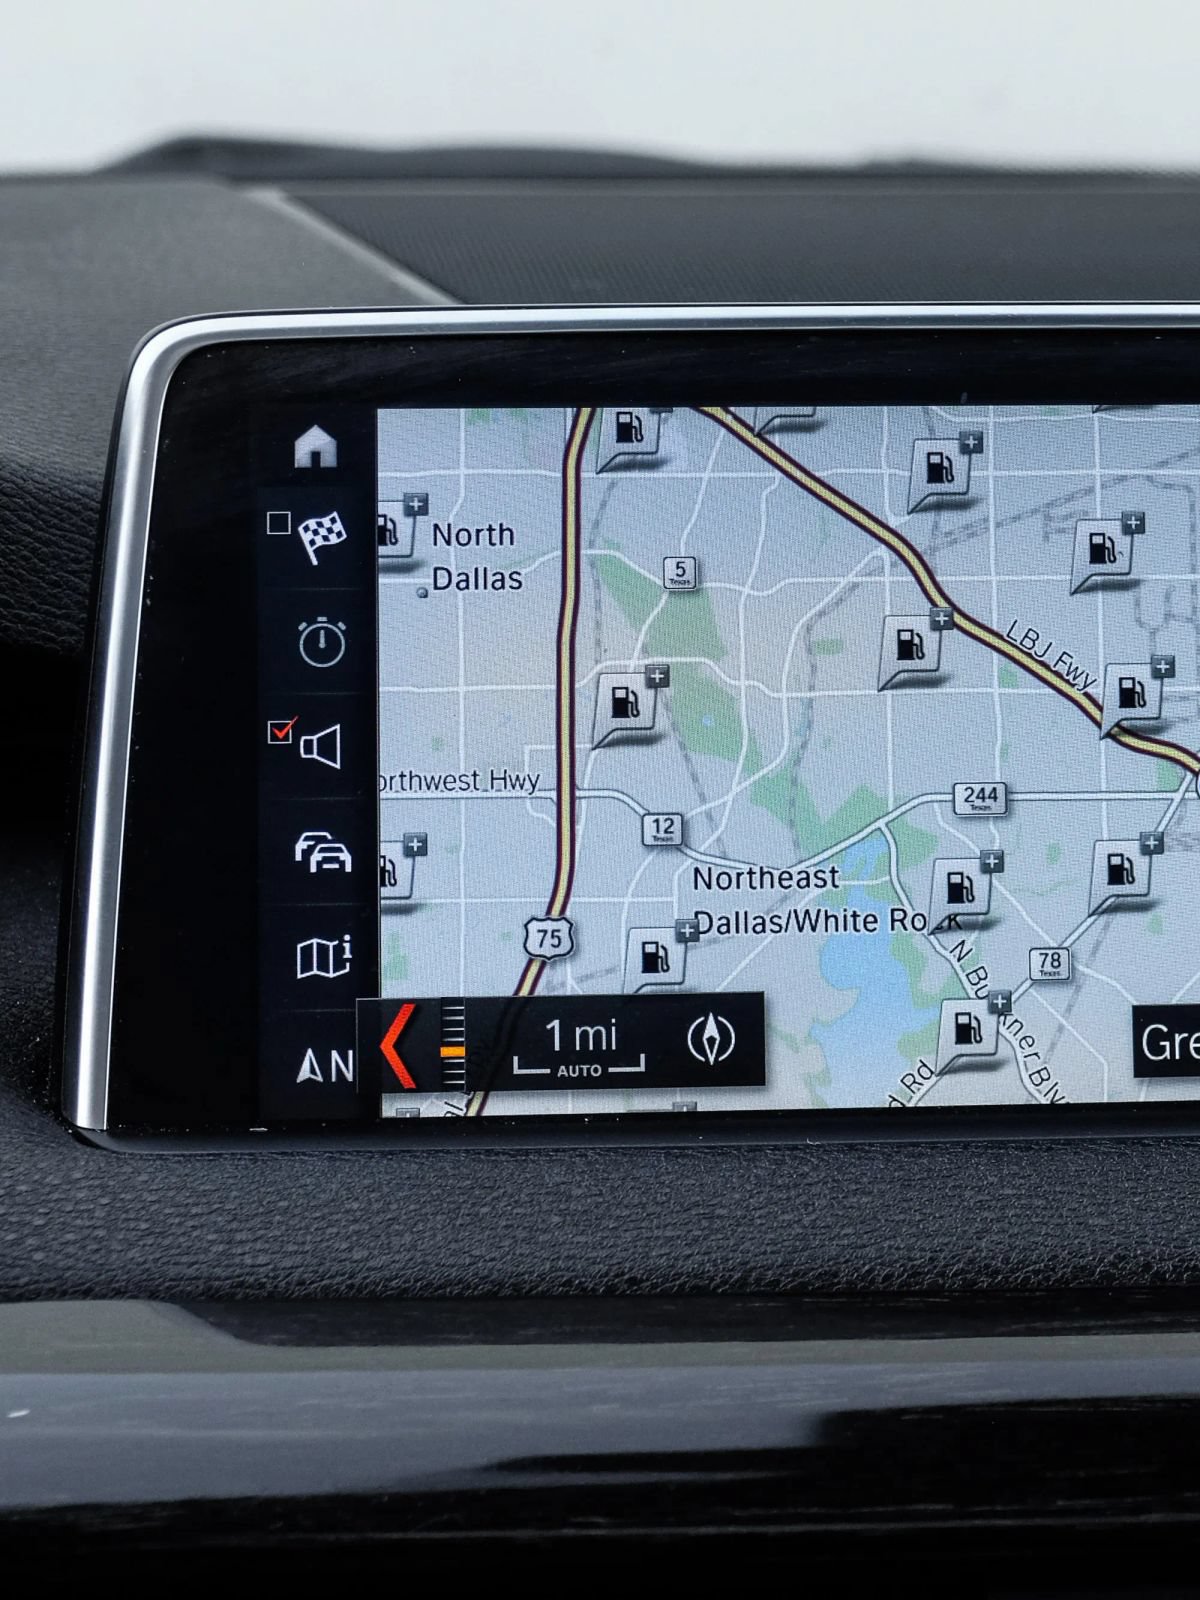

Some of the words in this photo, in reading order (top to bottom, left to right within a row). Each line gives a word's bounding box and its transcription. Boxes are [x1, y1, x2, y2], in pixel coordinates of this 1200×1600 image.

[433, 523, 515, 547] North
[433, 566, 523, 591] Dallas
[676, 561, 686, 577] 5
[1006, 619, 1053, 658] LBJ
[1053, 651, 1098, 691] Fwy
[380, 770, 480, 791] orthwest
[490, 769, 541, 796] Hwy
[964, 786, 998, 803] 244
[652, 817, 674, 834] 12
[693, 865, 840, 890] Northeast
[694, 908, 879, 935] Dallas/White
[890, 908, 963, 931] Rok
[537, 929, 561, 948] 75
[1039, 952, 1061, 969] 78
[949, 939, 973, 962] N
[965, 966, 1041, 1061] Bukner
[1029, 1066, 1070, 1104] Blv
[546, 1019, 562, 1052] 1
[575, 1018, 617, 1051] mi
[557, 1064, 602, 1078] AUTO
[900, 1059, 936, 1094] Rd
